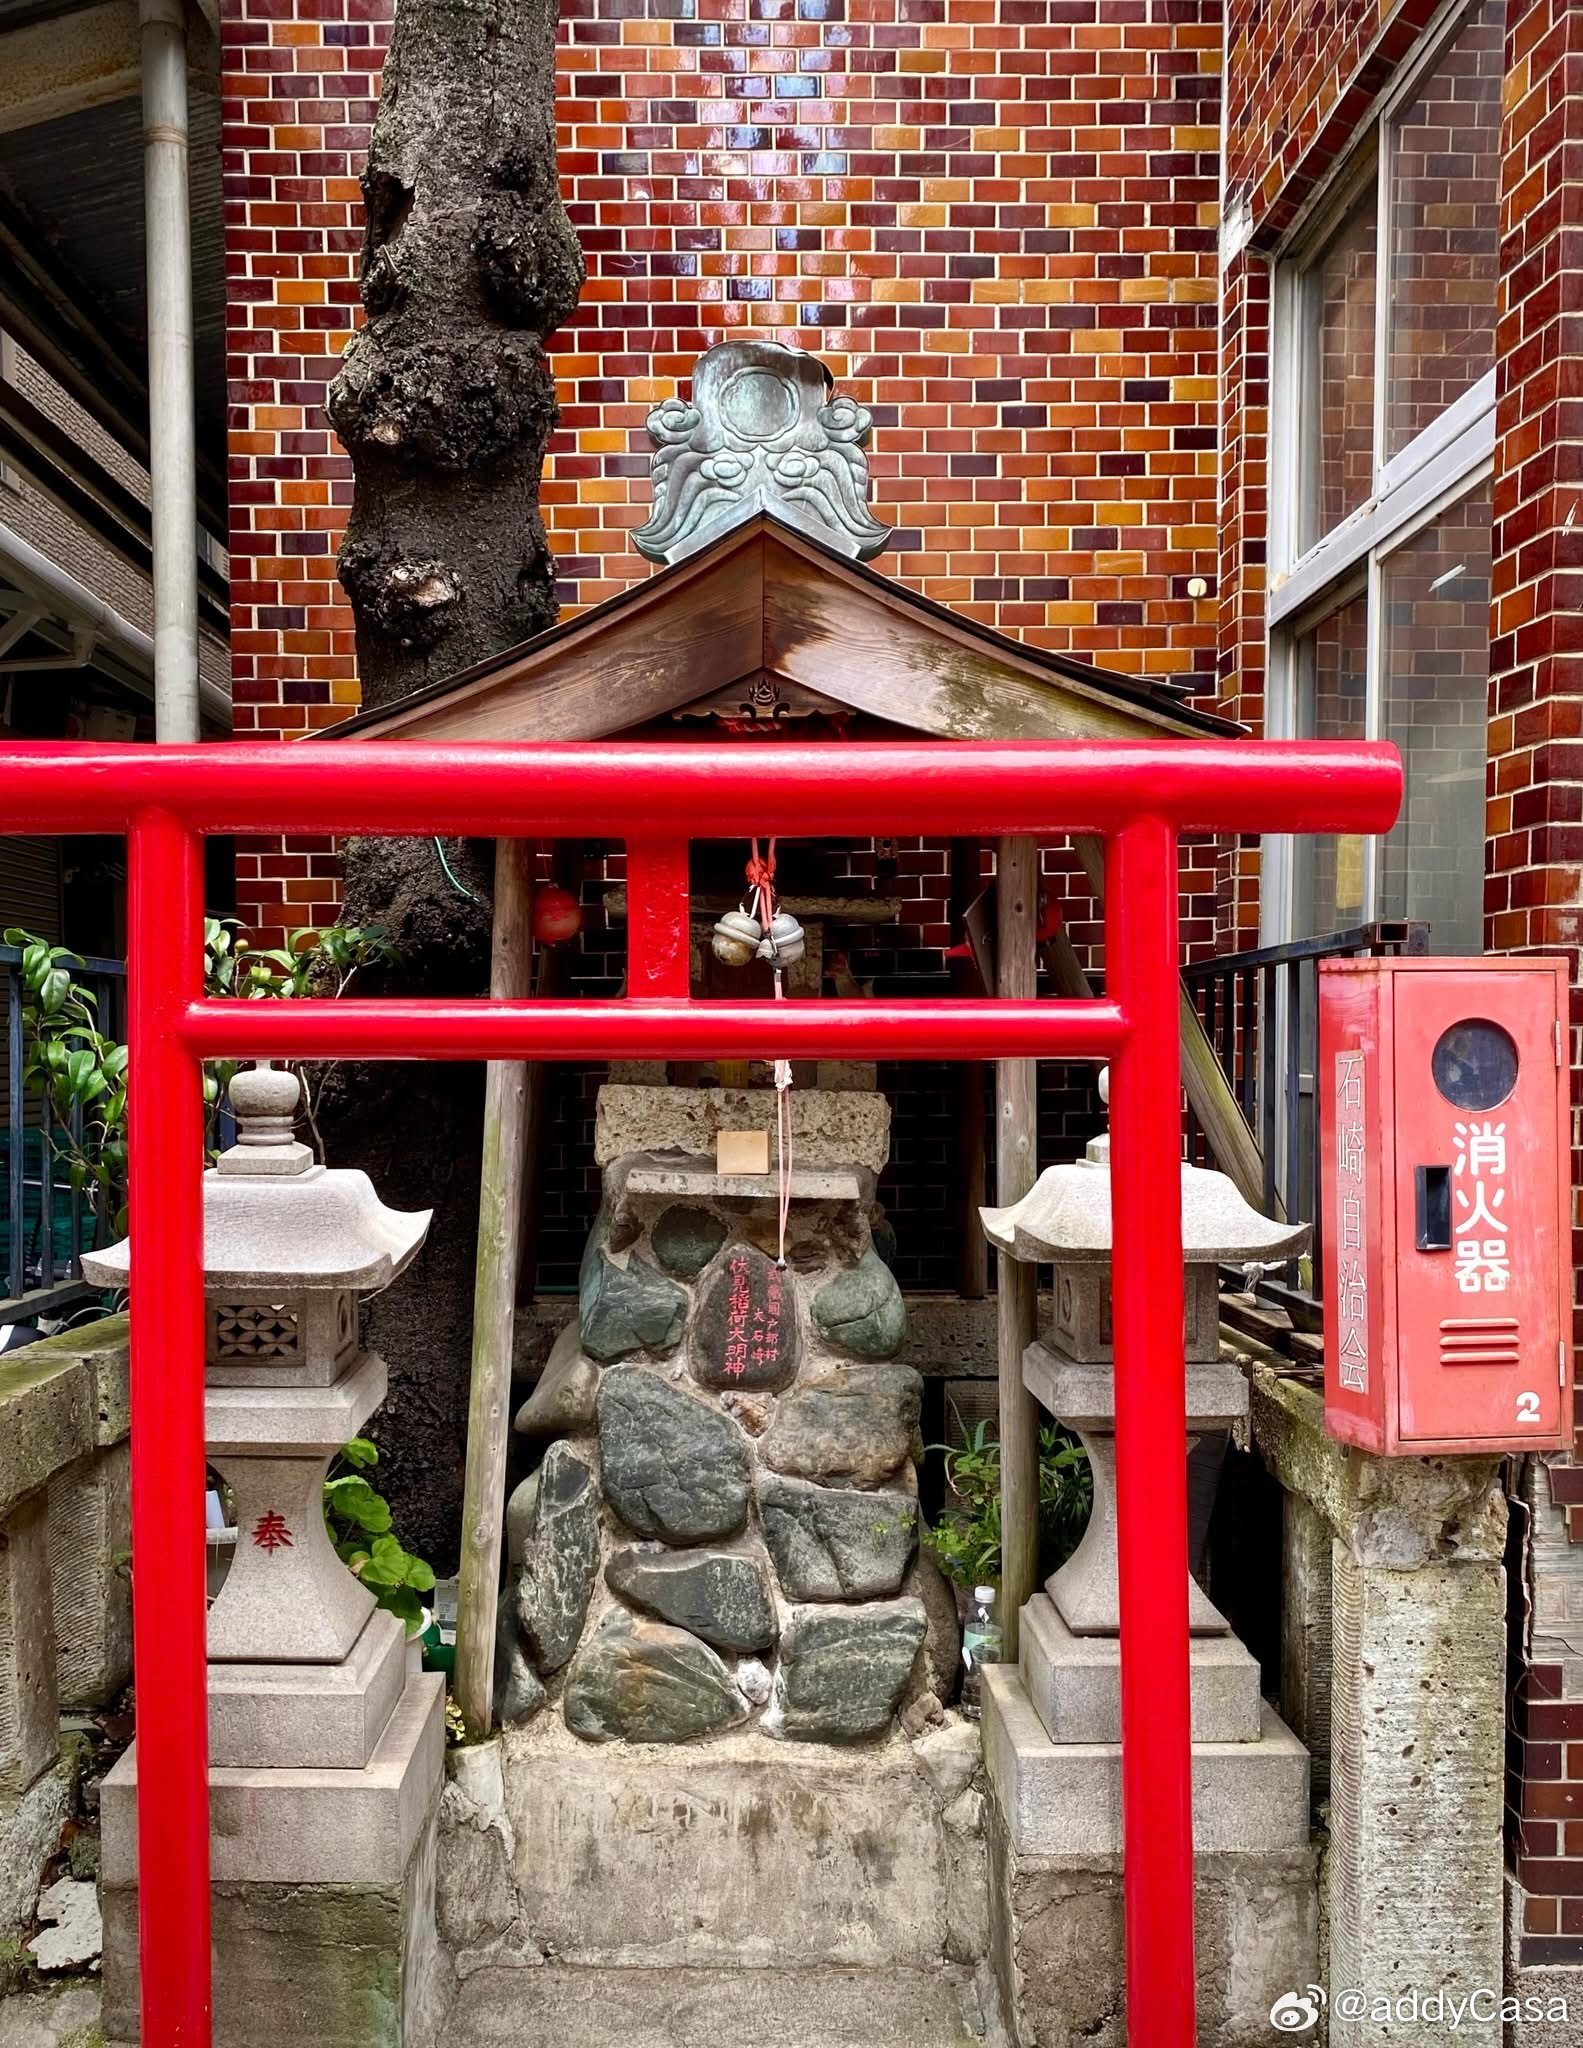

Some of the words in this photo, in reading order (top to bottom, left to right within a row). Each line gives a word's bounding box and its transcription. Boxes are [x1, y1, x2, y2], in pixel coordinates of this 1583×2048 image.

[1336, 1054, 1367, 1394] 石崎自治会
[1452, 1121, 1511, 1293] 消火器
[1515, 1390, 1542, 1423] 2
[251, 1510, 294, 1557] 奉
